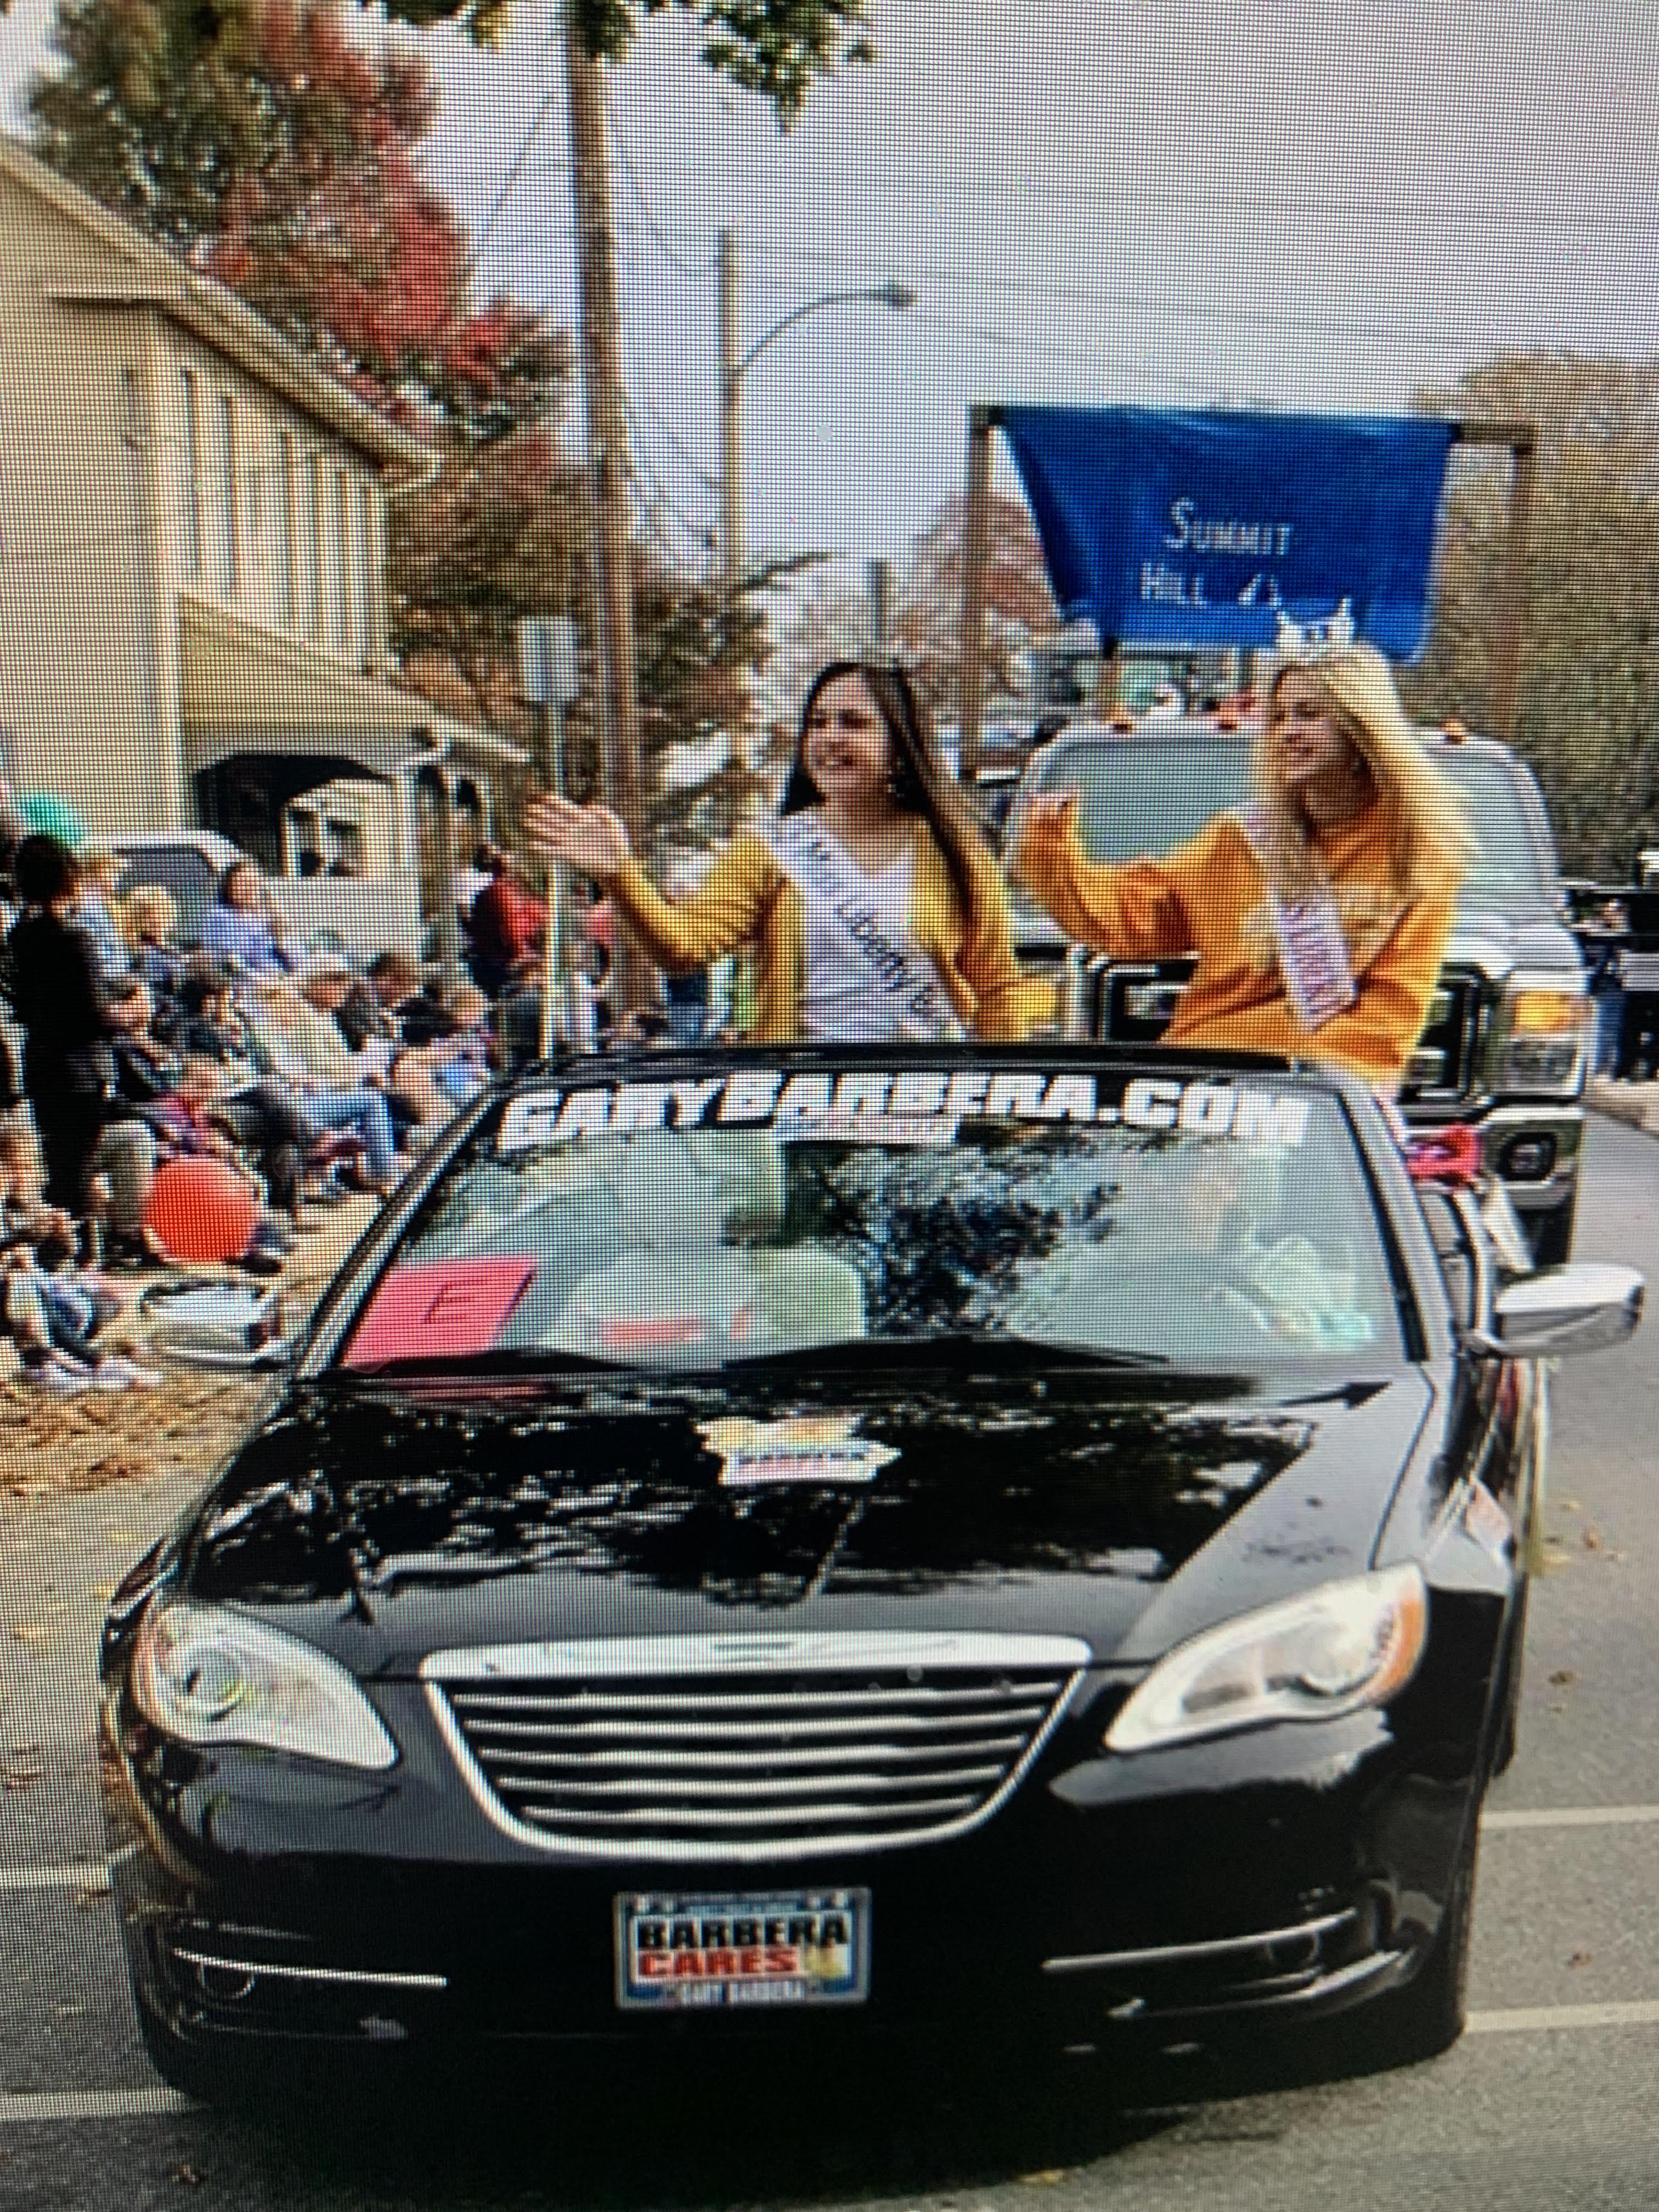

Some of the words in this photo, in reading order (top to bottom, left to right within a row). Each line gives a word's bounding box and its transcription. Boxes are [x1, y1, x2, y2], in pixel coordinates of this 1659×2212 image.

[497, 1070, 1311, 1152] GARYBARBERA.COM
[422, 1278, 489, 1324] E
[637, 1915, 849, 1949] BARBERA
[639, 1948, 795, 1976] CARES
